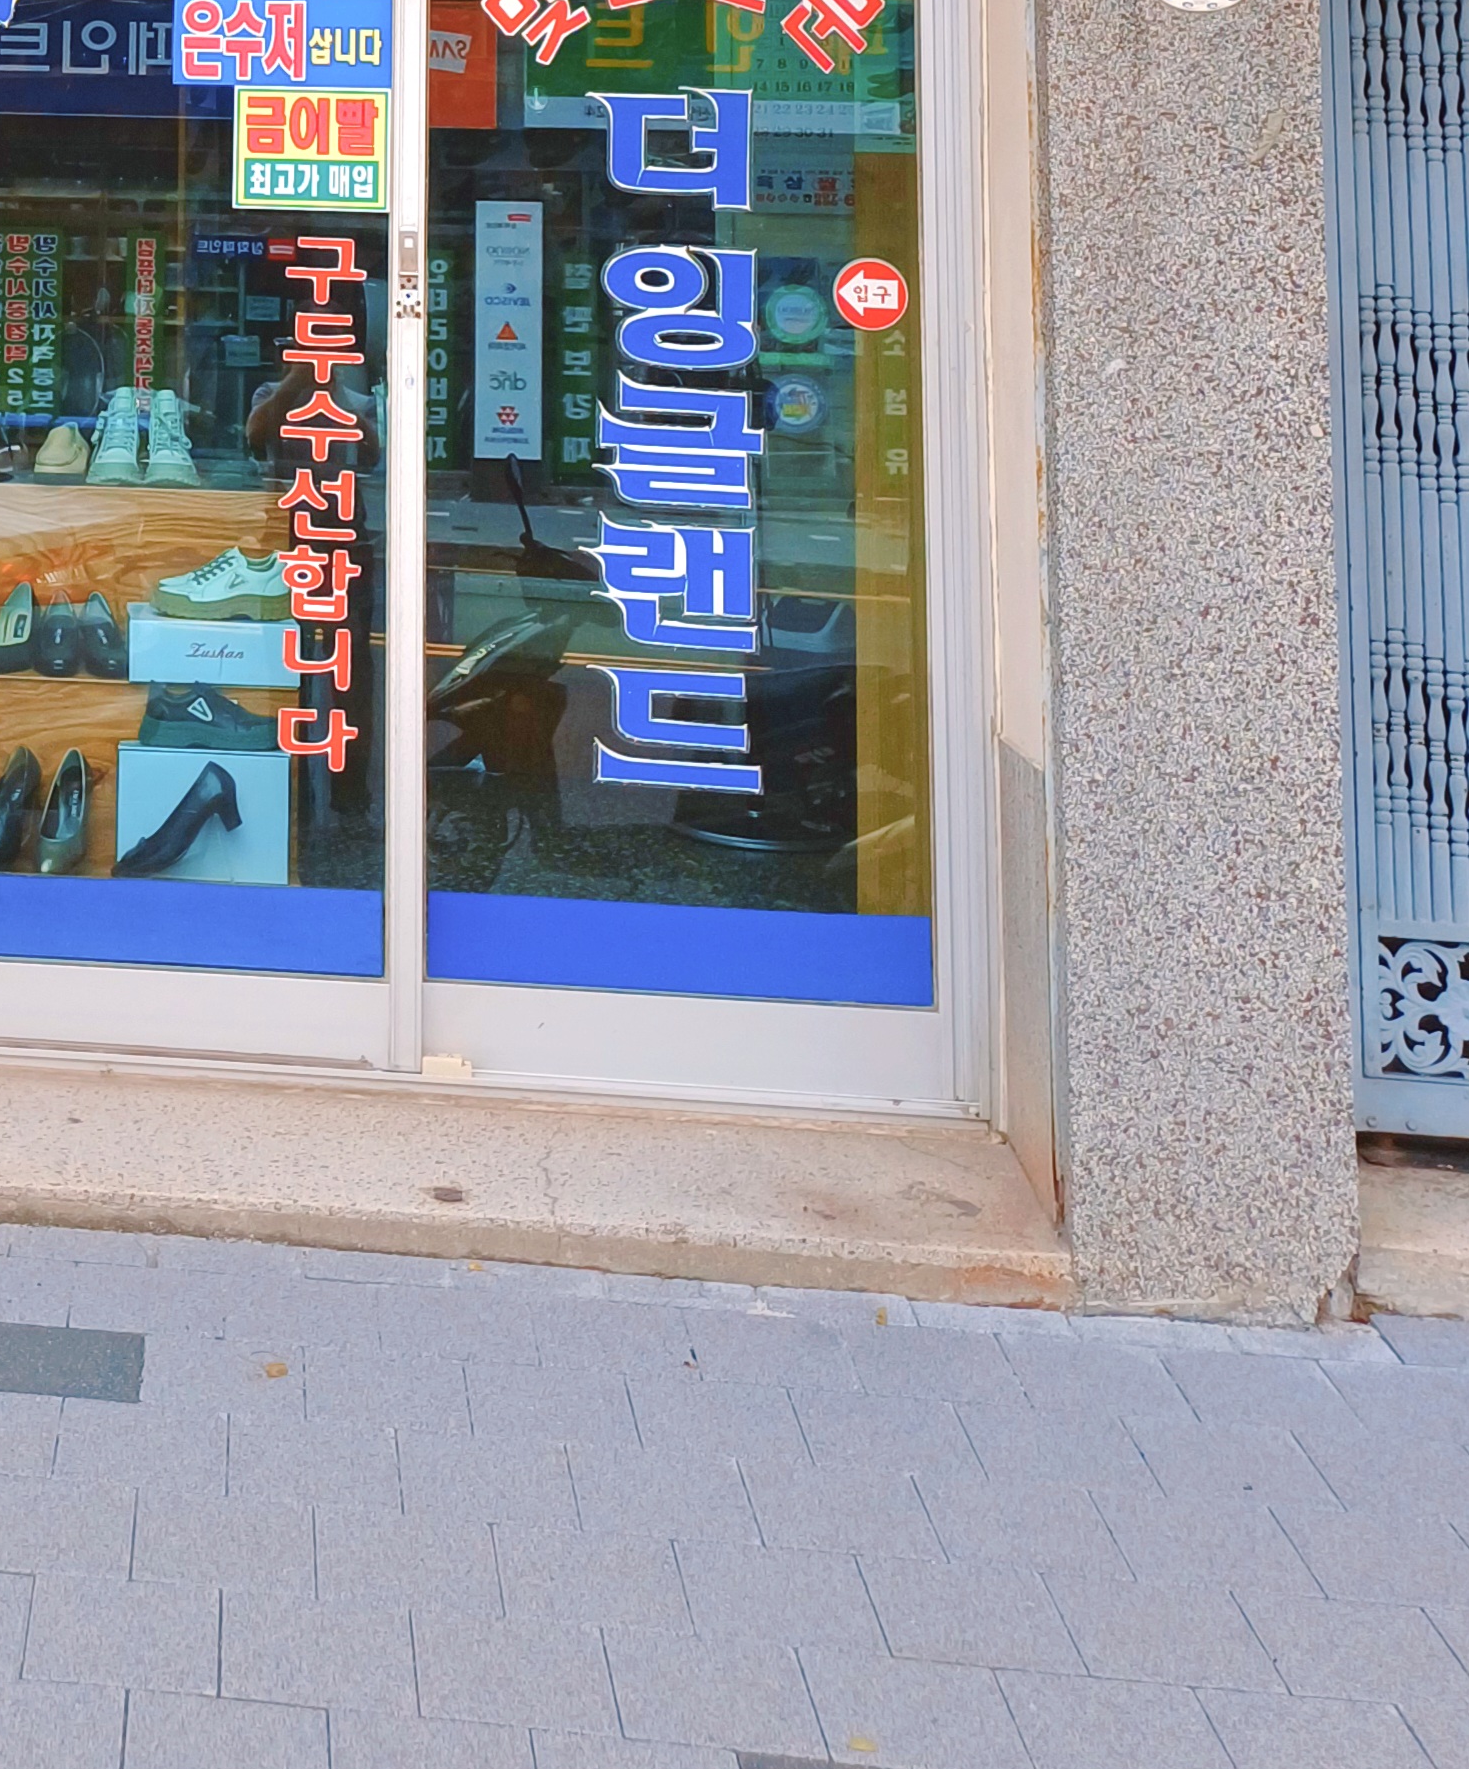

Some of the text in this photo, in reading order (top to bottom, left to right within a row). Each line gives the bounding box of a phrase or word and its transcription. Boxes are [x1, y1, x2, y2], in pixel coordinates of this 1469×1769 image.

[308, 27, 383, 68] 삽니다
[775, 81, 790, 93] 15
[796, 81, 812, 93] 16
[245, 96, 379, 158] 금이빨
[249, 163, 375, 199] 최고가 매입
[852, 284, 892, 305] 입구
[579, 86, 765, 795] 더잉글랜드
[277, 236, 368, 774] 구두수선합니다
